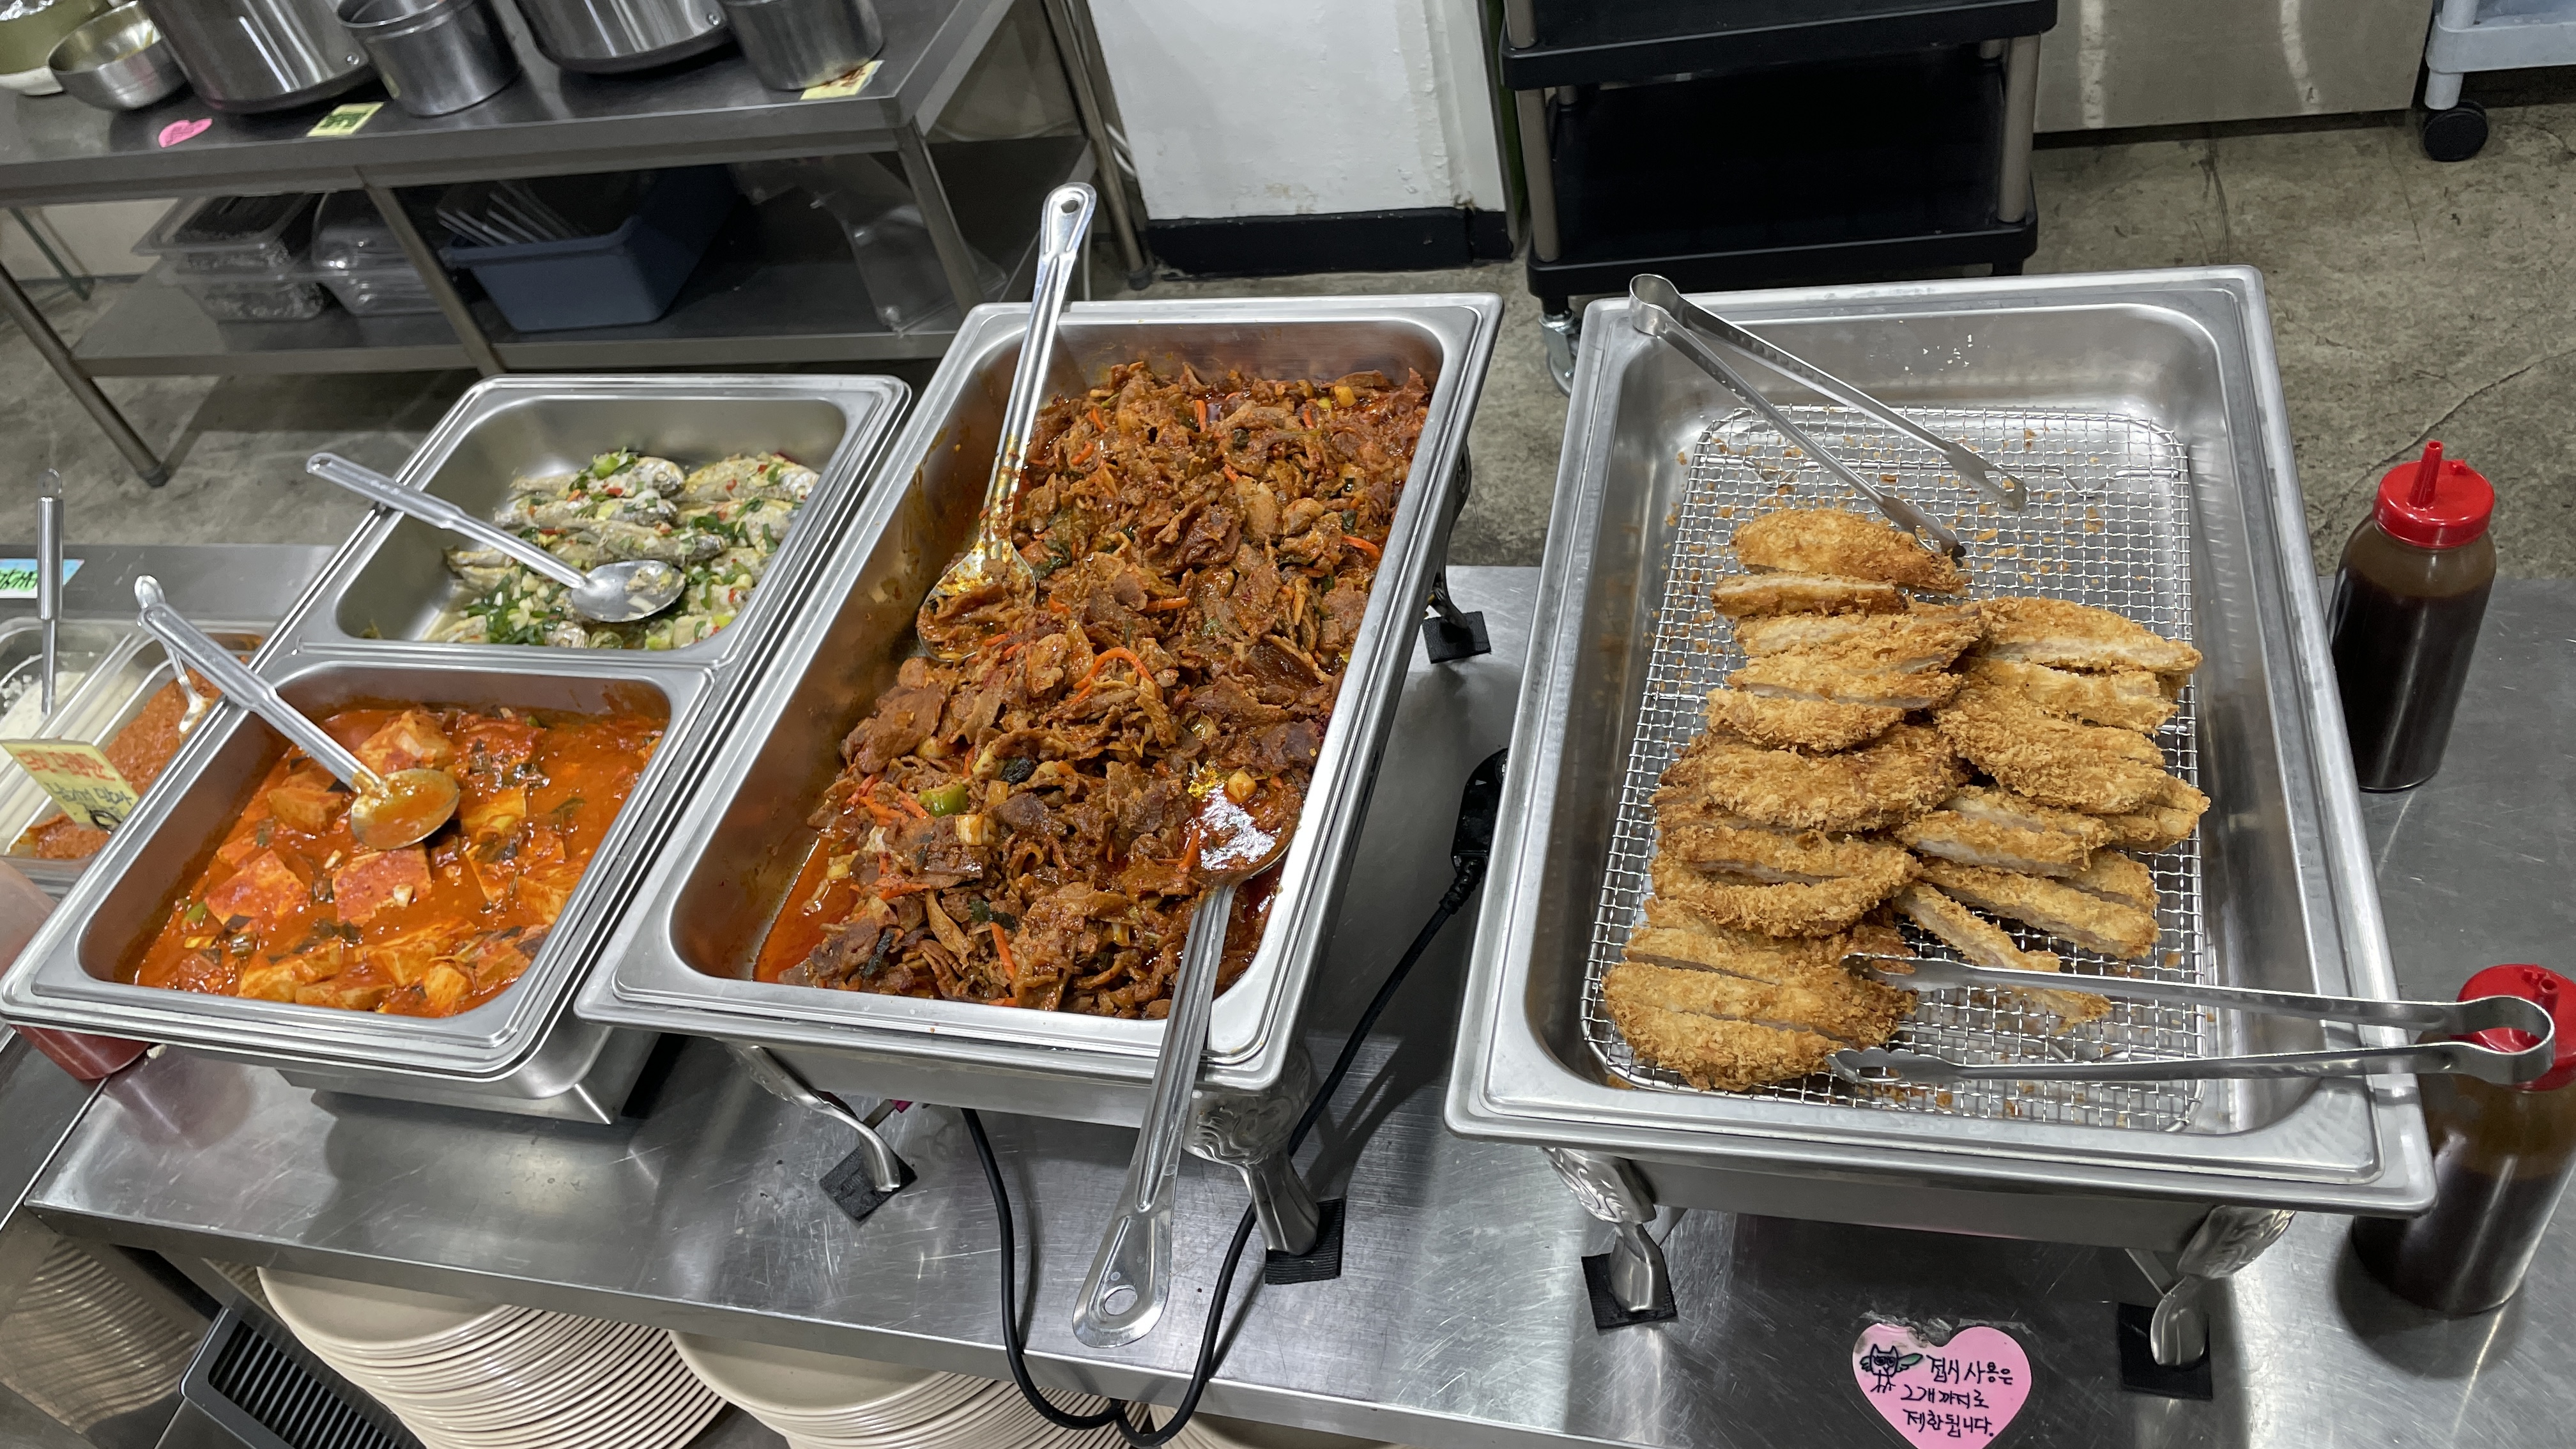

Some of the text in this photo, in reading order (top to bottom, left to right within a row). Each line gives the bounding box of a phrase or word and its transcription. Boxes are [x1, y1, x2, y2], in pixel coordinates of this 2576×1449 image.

[1963, 1360, 2013, 1385] 사용은
[1900, 1384, 1989, 1409] 2개까지로
[1902, 1409, 1994, 1438] 제한됩니다.
